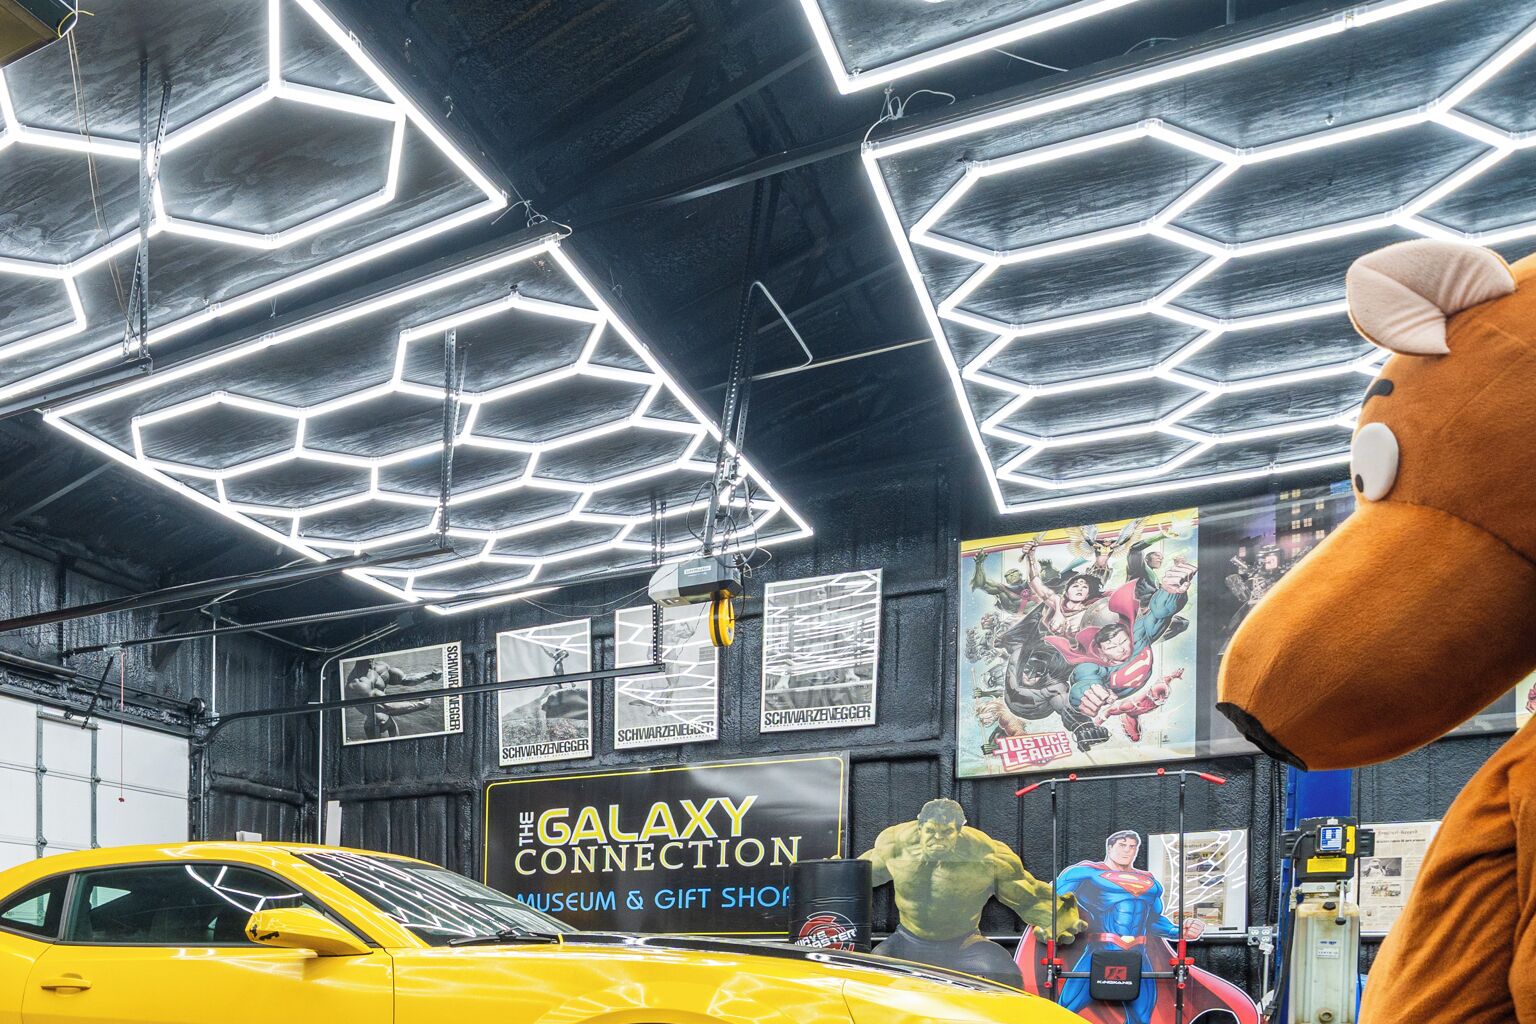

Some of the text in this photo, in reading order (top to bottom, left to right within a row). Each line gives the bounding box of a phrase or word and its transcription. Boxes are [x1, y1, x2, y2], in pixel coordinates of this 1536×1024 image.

[446, 645, 461, 731] SCHWARNEGGER
[764, 706, 871, 726] SCHWARZENEGGER
[617, 720, 715, 743] SCHWARZENEGGER
[994, 732, 1070, 754] JUSTICE
[502, 739, 590, 760] SCHWARZENEGGER
[1004, 743, 1072, 766] LEAGUE
[519, 795, 759, 847] THE GALAXY
[514, 835, 803, 876] CONNECTION
[517, 890, 616, 913] MUSEUM
[626, 890, 644, 910] &
[654, 888, 711, 910] GIFT
[805, 927, 857, 949] ASTER
